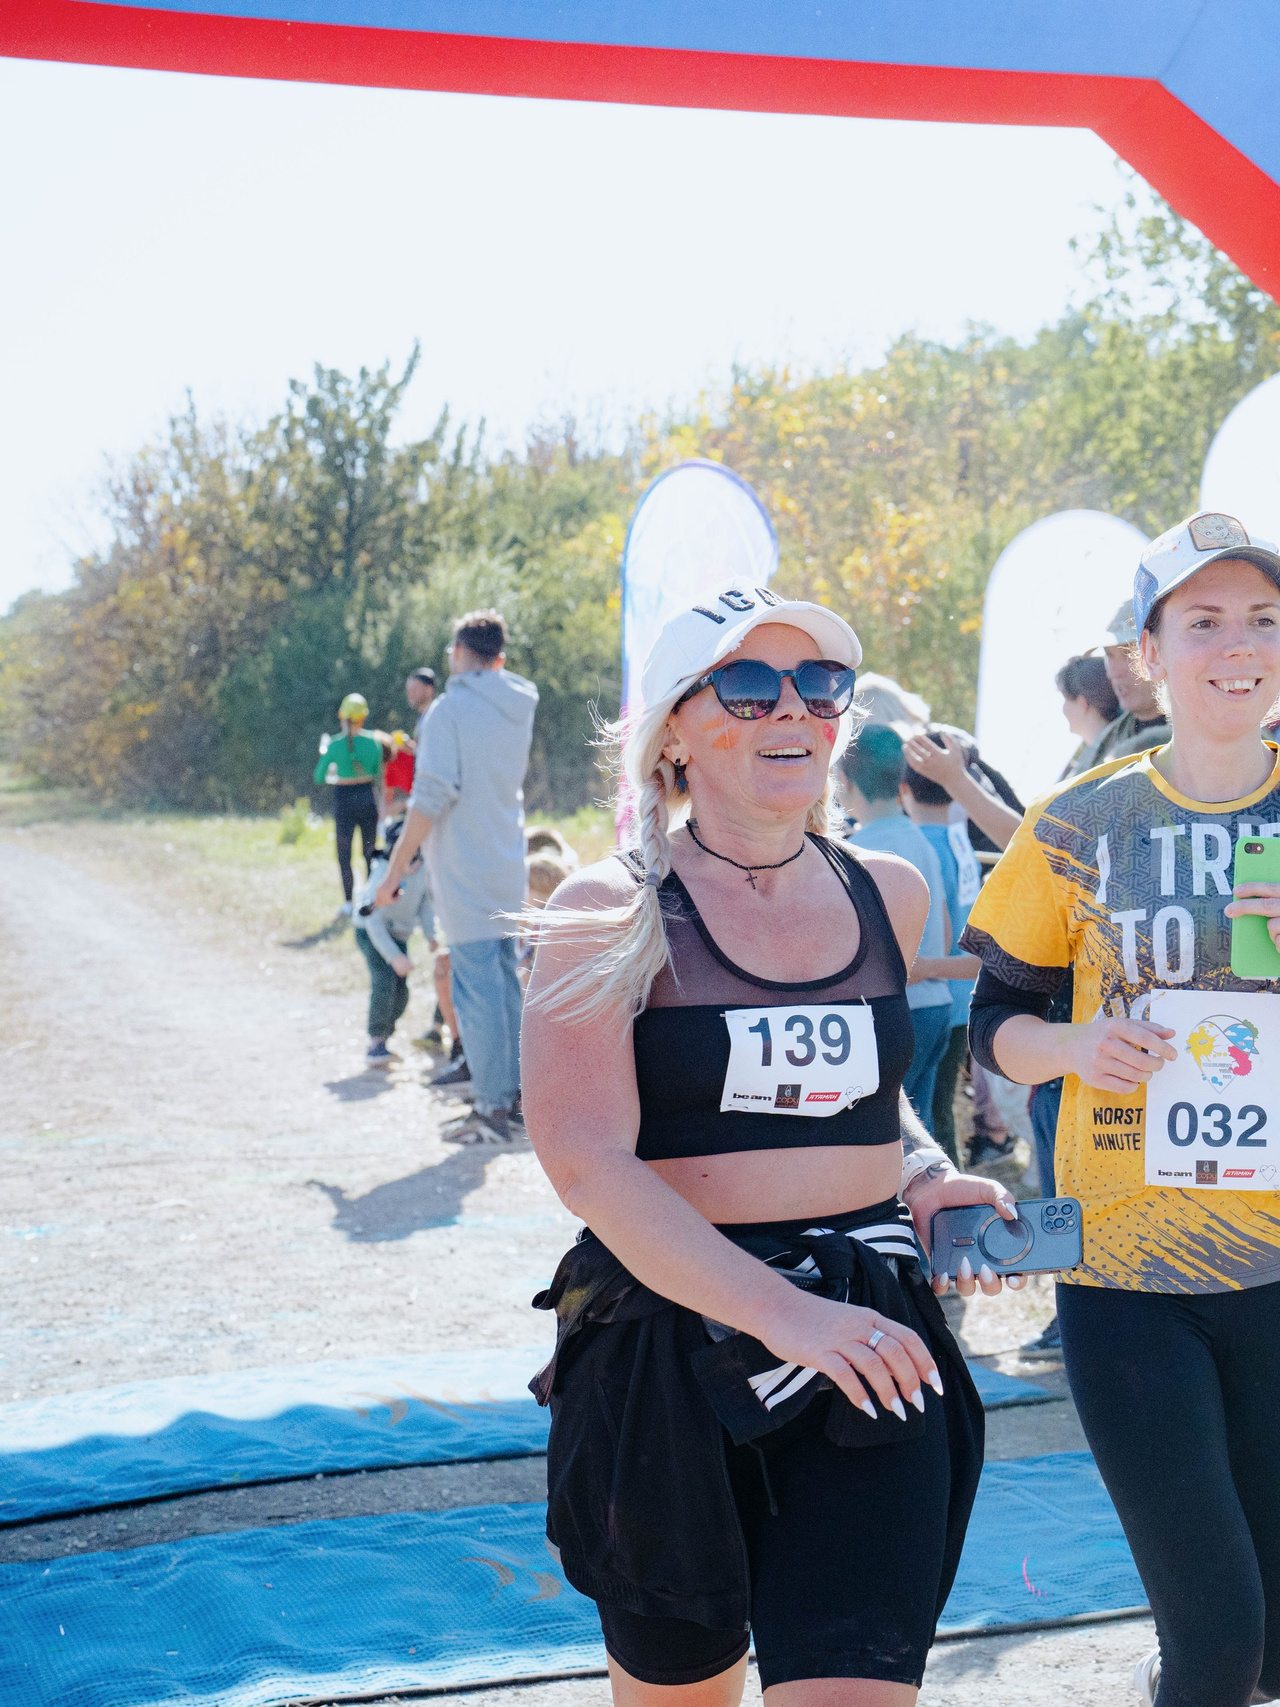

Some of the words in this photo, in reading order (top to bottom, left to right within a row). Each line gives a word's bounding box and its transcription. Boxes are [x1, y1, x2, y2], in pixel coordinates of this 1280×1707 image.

[1110, 905, 1195, 985] TO
[748, 1013, 852, 1067] 139
[775, 1096, 800, 1106] copy
[1093, 1107, 1144, 1126] WORST
[1167, 1101, 1268, 1148] 032
[1092, 1132, 1142, 1151] MINUTE
[1157, 1169, 1173, 1177] be
